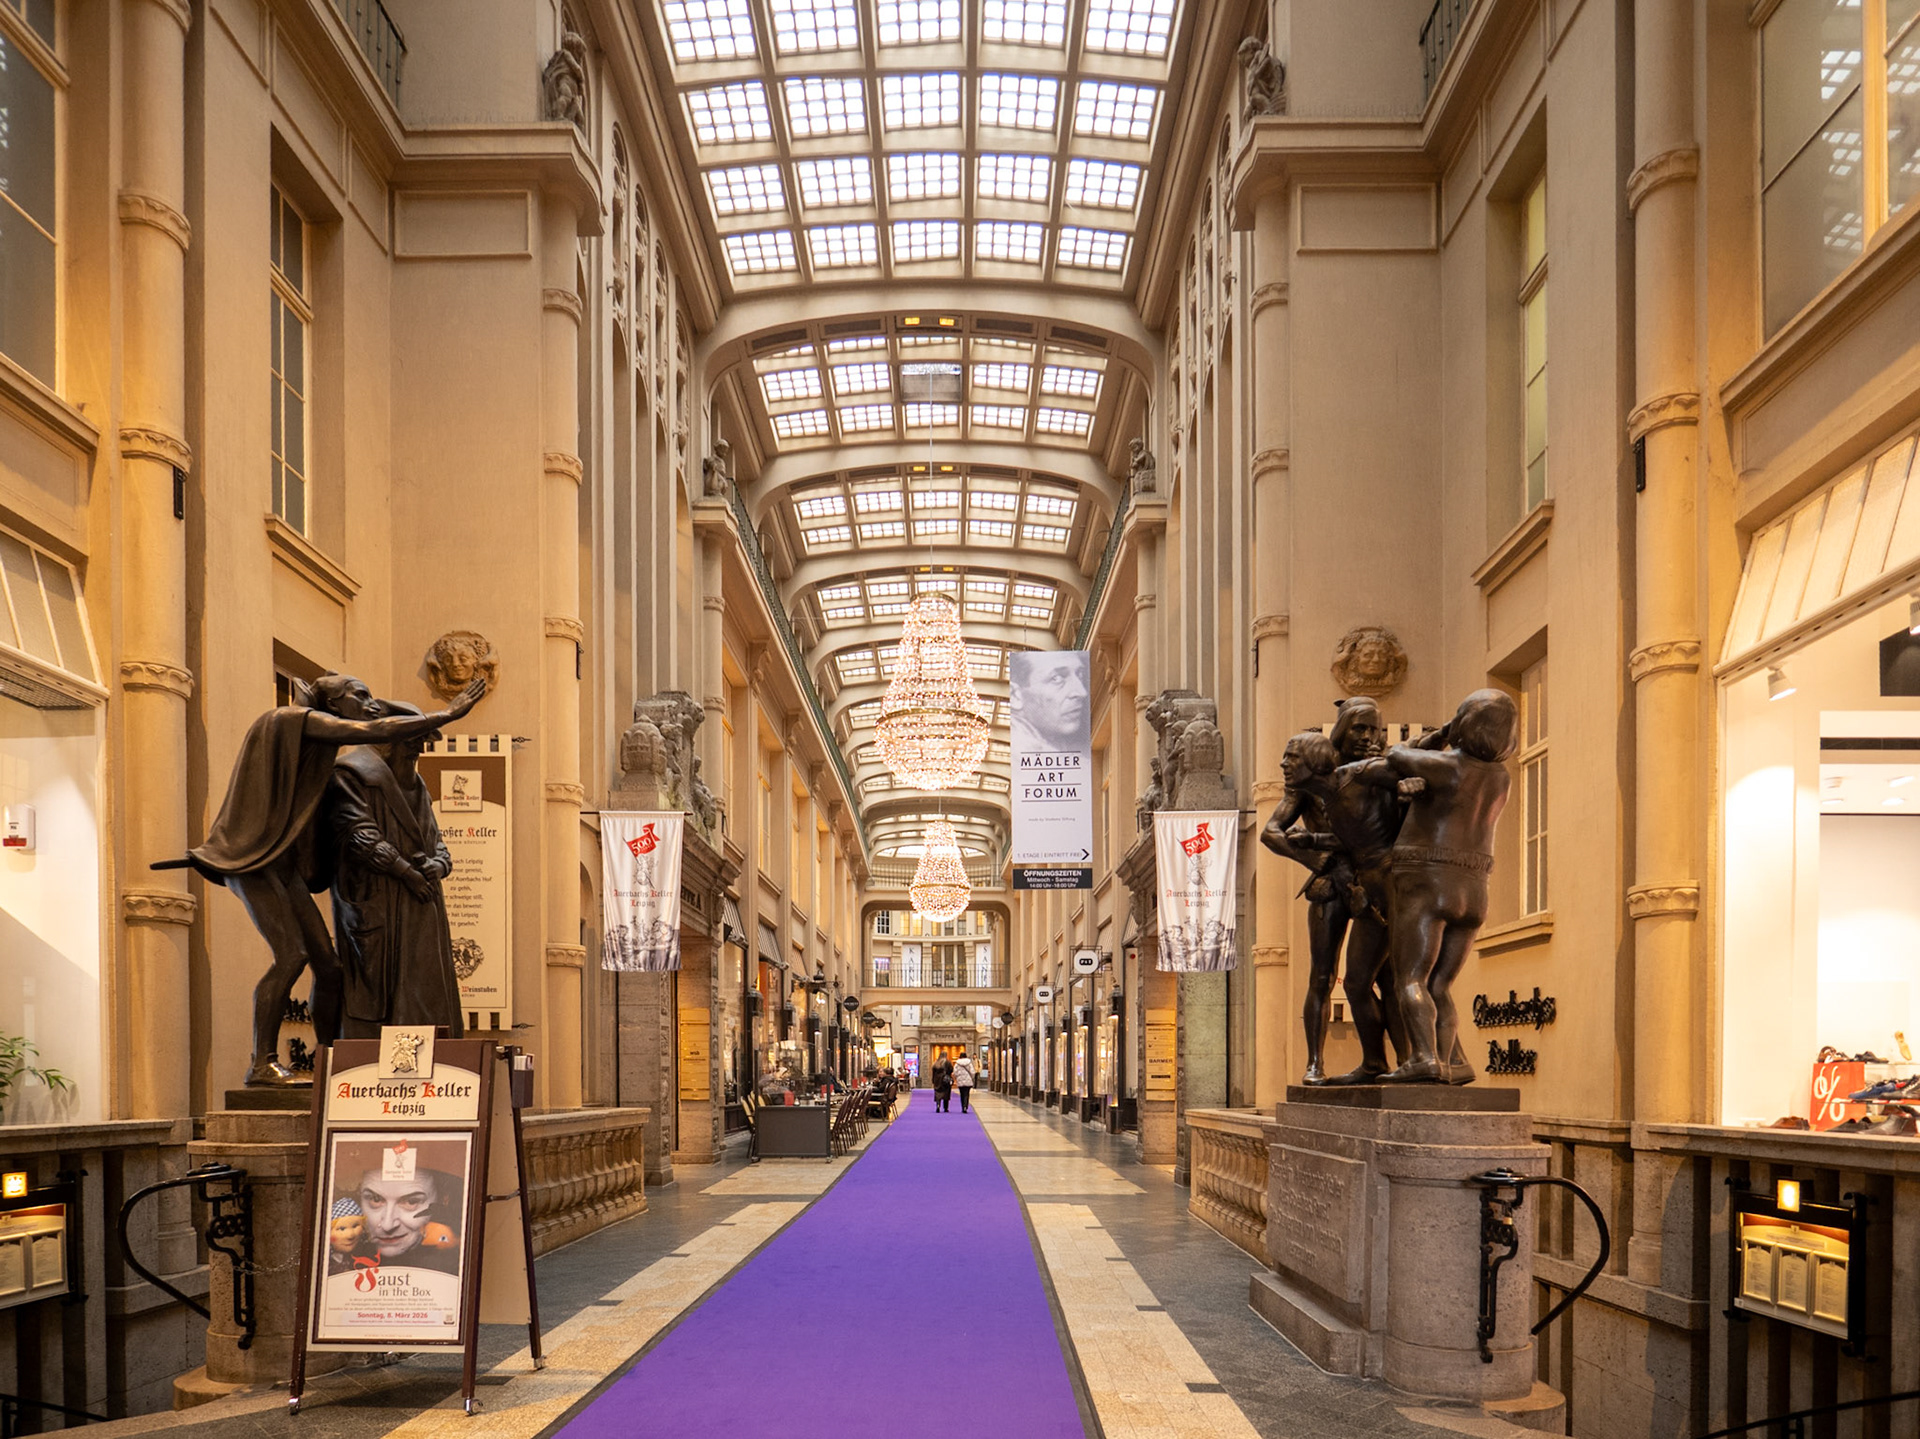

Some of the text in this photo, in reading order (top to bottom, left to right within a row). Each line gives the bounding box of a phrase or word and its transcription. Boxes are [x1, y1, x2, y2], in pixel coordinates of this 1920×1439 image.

[1021, 753, 1080, 767] MÄDLER
[1038, 772, 1064, 782] ART
[1025, 788, 1077, 798] FORUM
[440, 826, 498, 838] roßer Keller
[631, 838, 651, 854] 500
[1185, 837, 1205, 854] 500
[613, 889, 674, 898] Auerbachs Keller
[1166, 890, 1202, 898] Auerbachs
[1185, 899, 1209, 908] Leipzig
[336, 1082, 472, 1100] Auerbachs Keller
[382, 1101, 426, 1116] Leipzig
[378, 1286, 431, 1296] in the Box
[357, 1312, 385, 1320] Sonntag,
